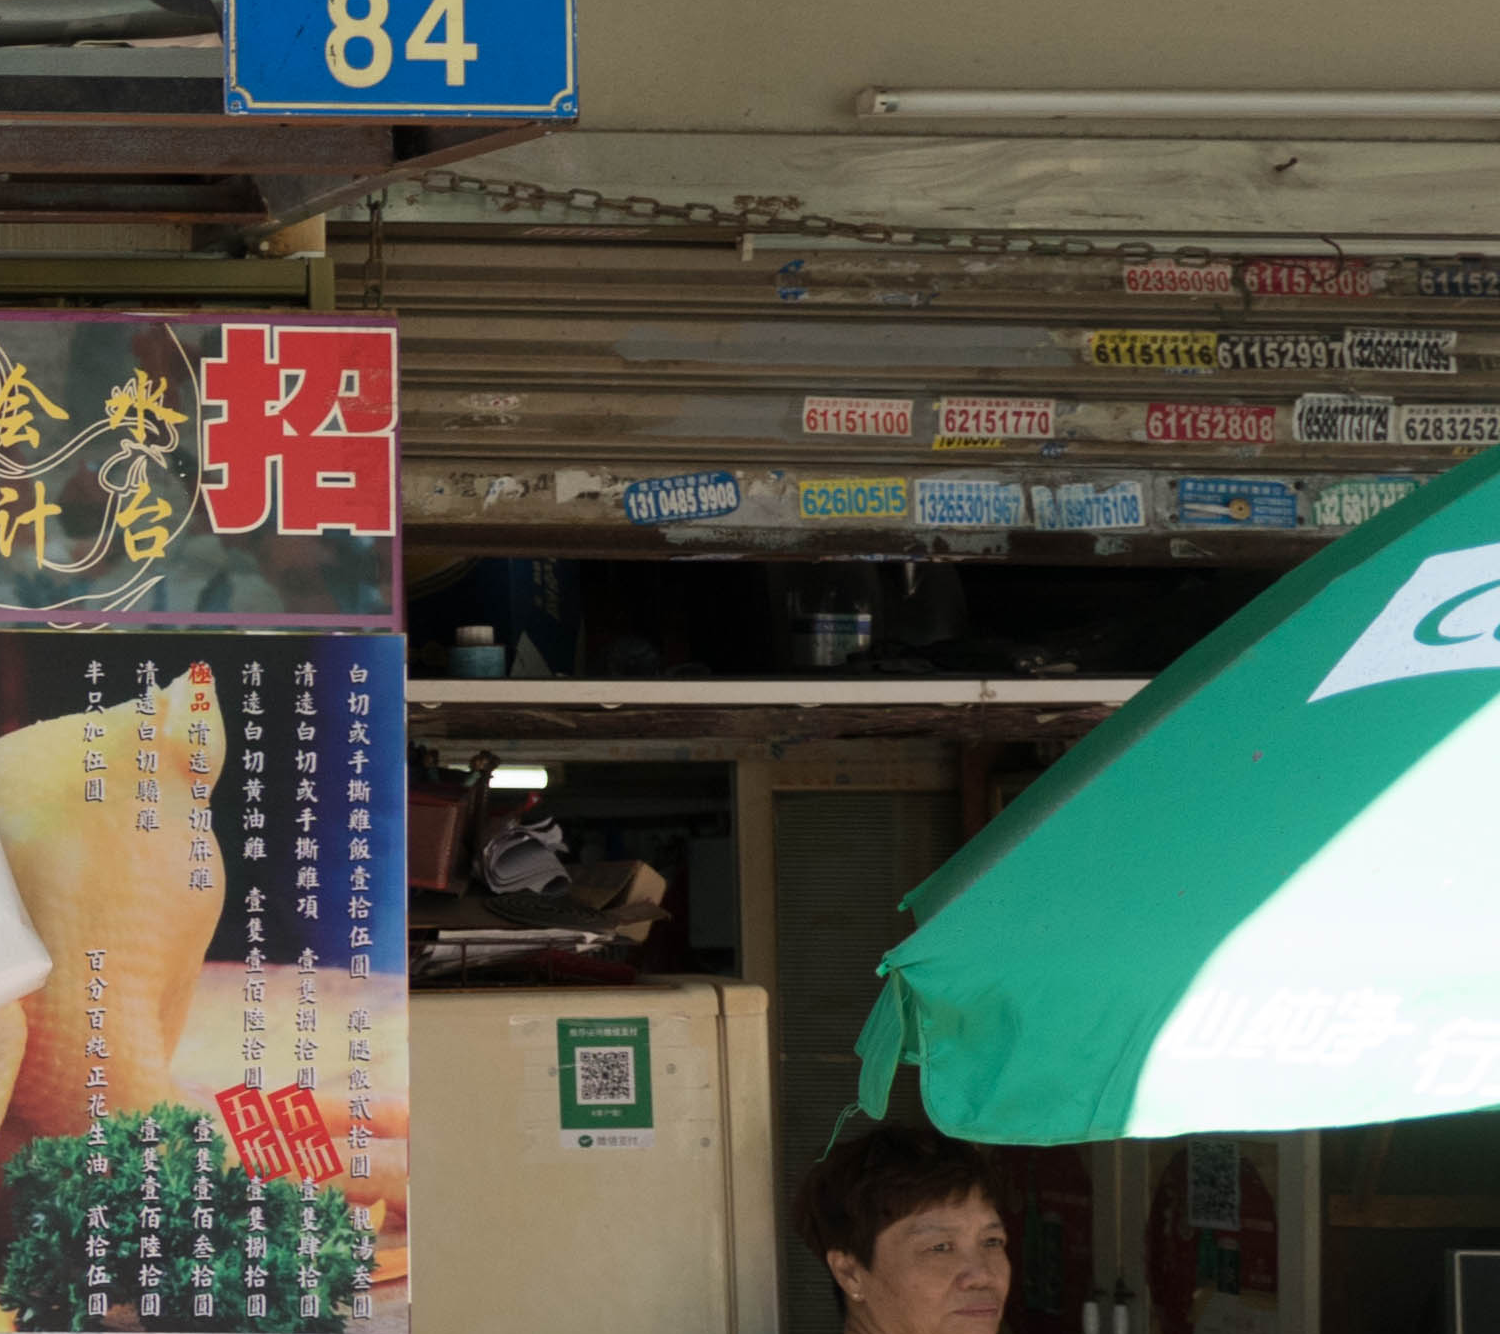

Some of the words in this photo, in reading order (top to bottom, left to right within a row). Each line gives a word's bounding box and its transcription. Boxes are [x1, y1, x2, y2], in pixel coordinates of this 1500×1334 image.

[1126, 269, 1229, 293] 62336090
[1094, 344, 1213, 365] 61151116
[1216, 341, 1345, 368] 61152997
[201, 323, 397, 537] 招
[805, 409, 909, 435] 61151100
[944, 410, 1050, 435] 62151770
[1148, 413, 1275, 441] 61152808
[629, 493, 656, 520] 131
[658, 489, 697, 517] 0485
[698, 482, 737, 511] 9908
